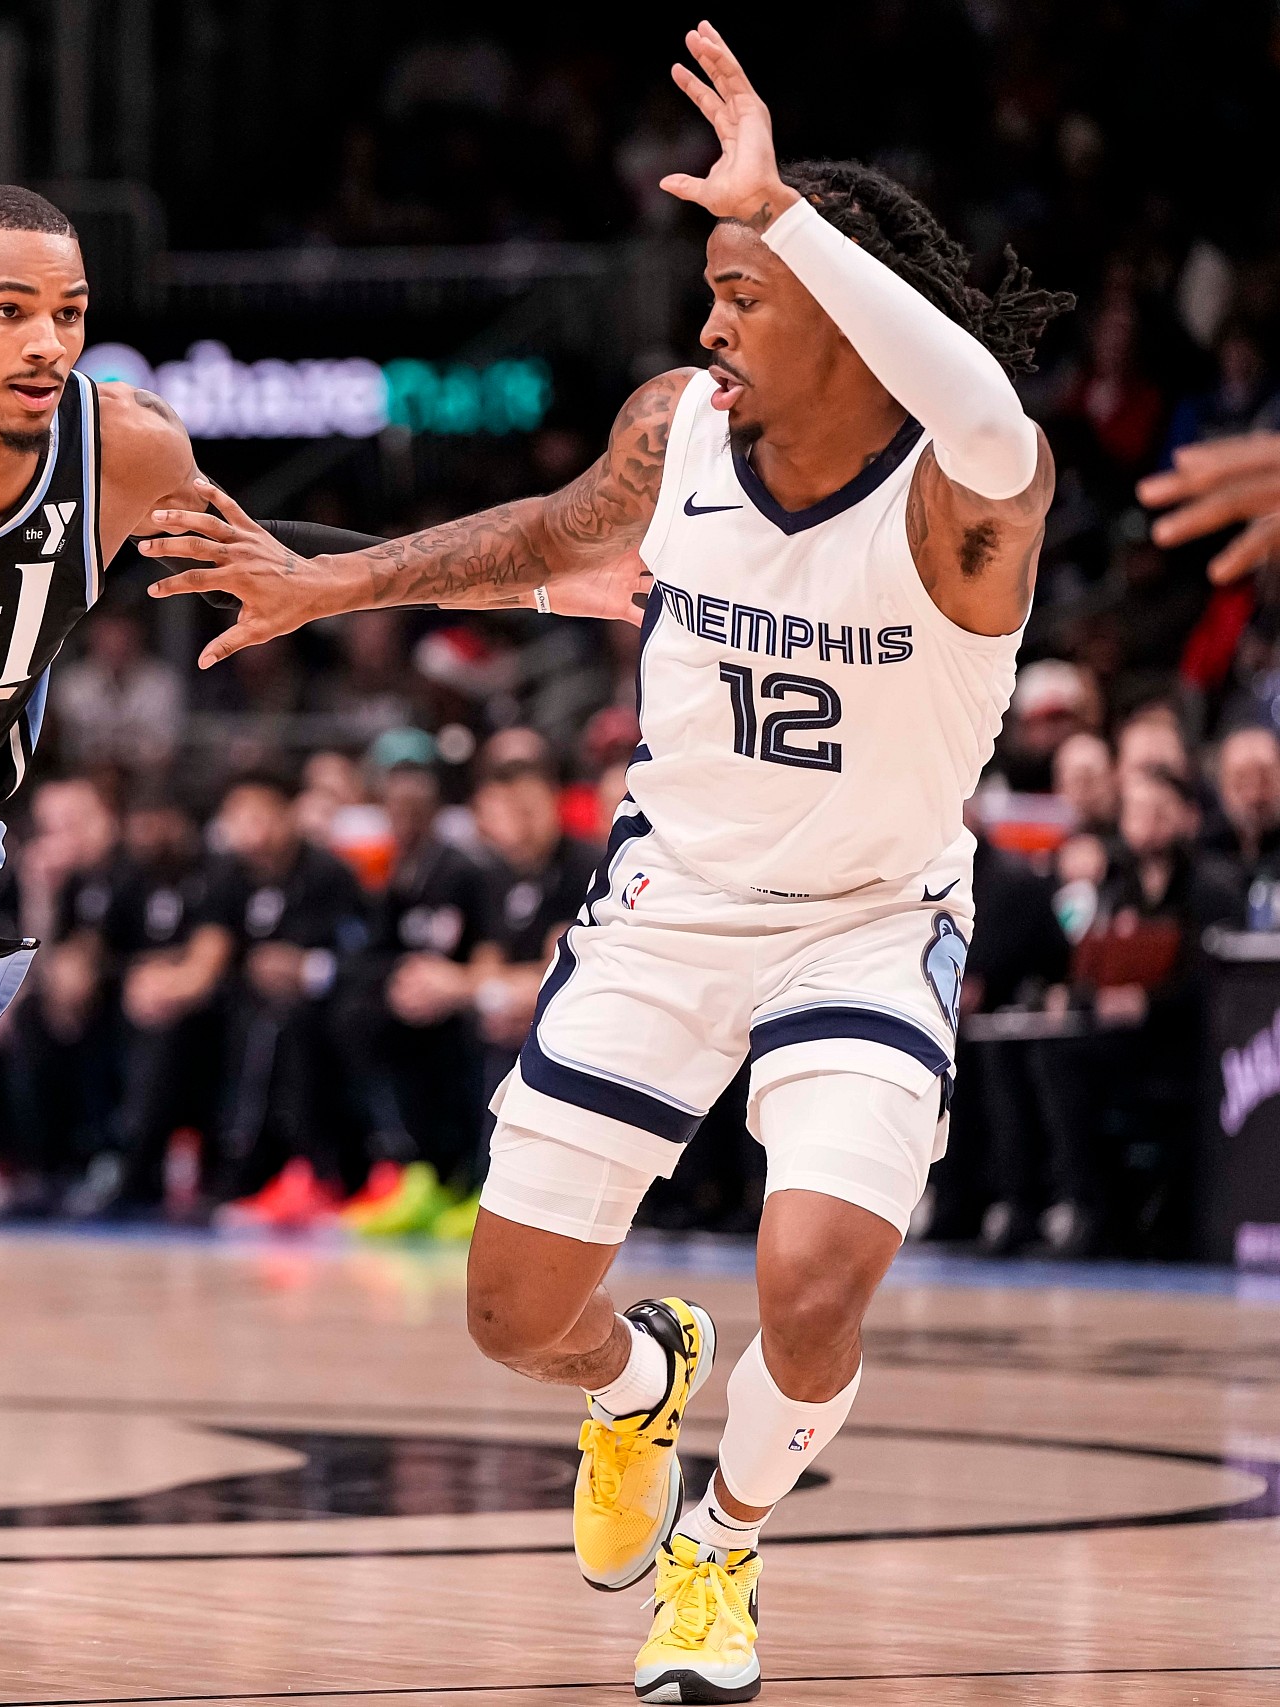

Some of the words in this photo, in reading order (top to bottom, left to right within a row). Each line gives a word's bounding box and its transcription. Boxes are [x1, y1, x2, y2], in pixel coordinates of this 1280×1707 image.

[25, 528, 44, 541] the
[657, 579, 914, 665] MEMPHIS
[719, 660, 842, 774] 12
